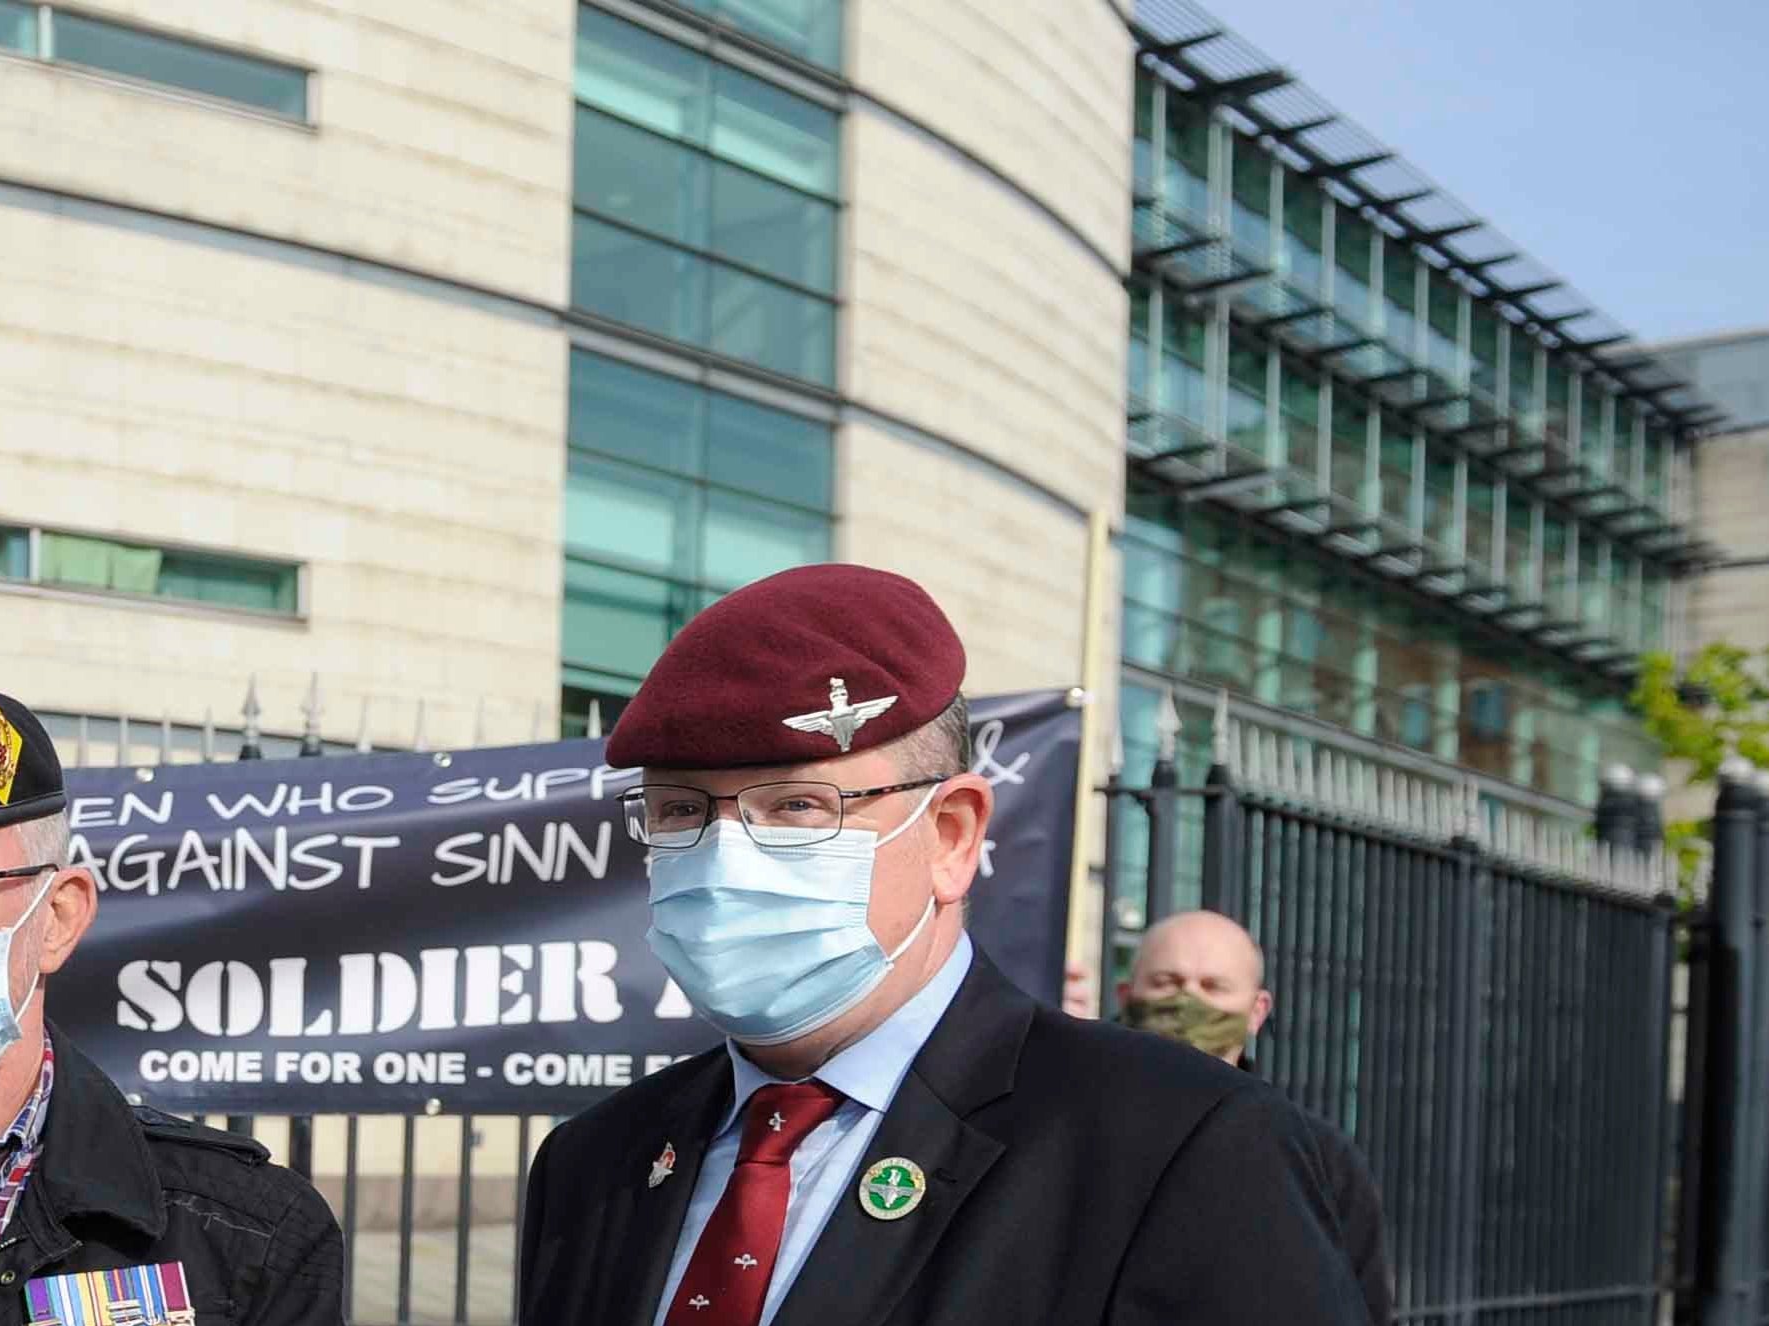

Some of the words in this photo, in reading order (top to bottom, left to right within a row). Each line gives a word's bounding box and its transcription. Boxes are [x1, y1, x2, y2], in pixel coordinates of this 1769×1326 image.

[70, 790, 174, 829] EN
[206, 781, 394, 820] WHO
[427, 764, 644, 805] SUPP
[68, 826, 401, 896] AGAINST
[431, 820, 612, 887] SINN
[117, 941, 623, 1038] SOLDIER
[139, 1050, 263, 1083] COME
[275, 1051, 363, 1084] FOR
[373, 1051, 467, 1084] ONE
[503, 1052, 632, 1087] COME
